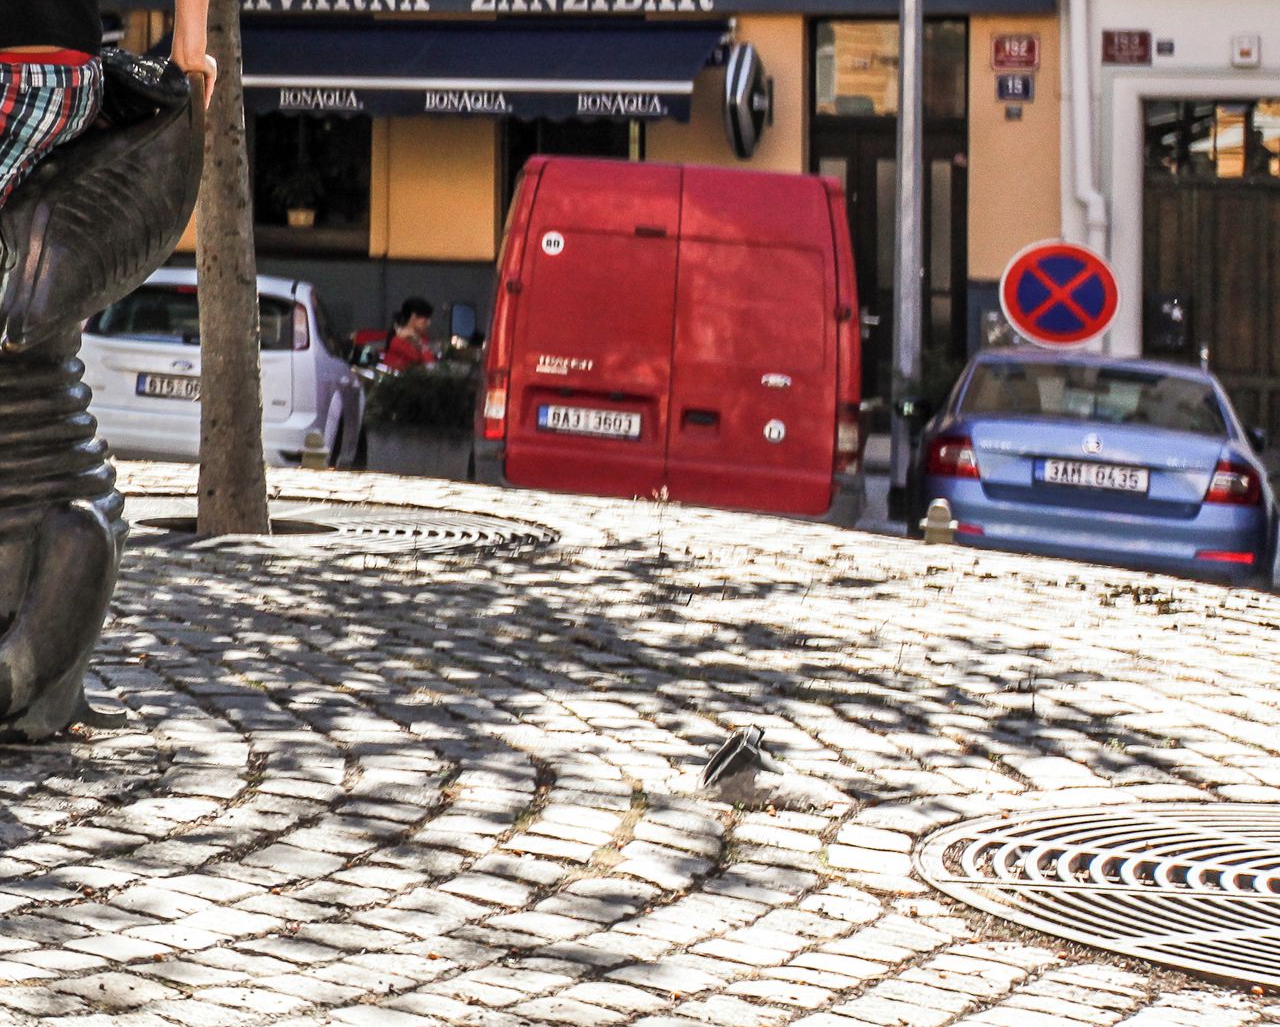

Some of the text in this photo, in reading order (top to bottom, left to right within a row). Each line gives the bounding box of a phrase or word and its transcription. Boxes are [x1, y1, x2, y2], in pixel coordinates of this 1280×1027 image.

[279, 88, 358, 110] BONAQUA
[425, 90, 507, 112] BONAQUA
[577, 93, 662, 115] BONAQUA
